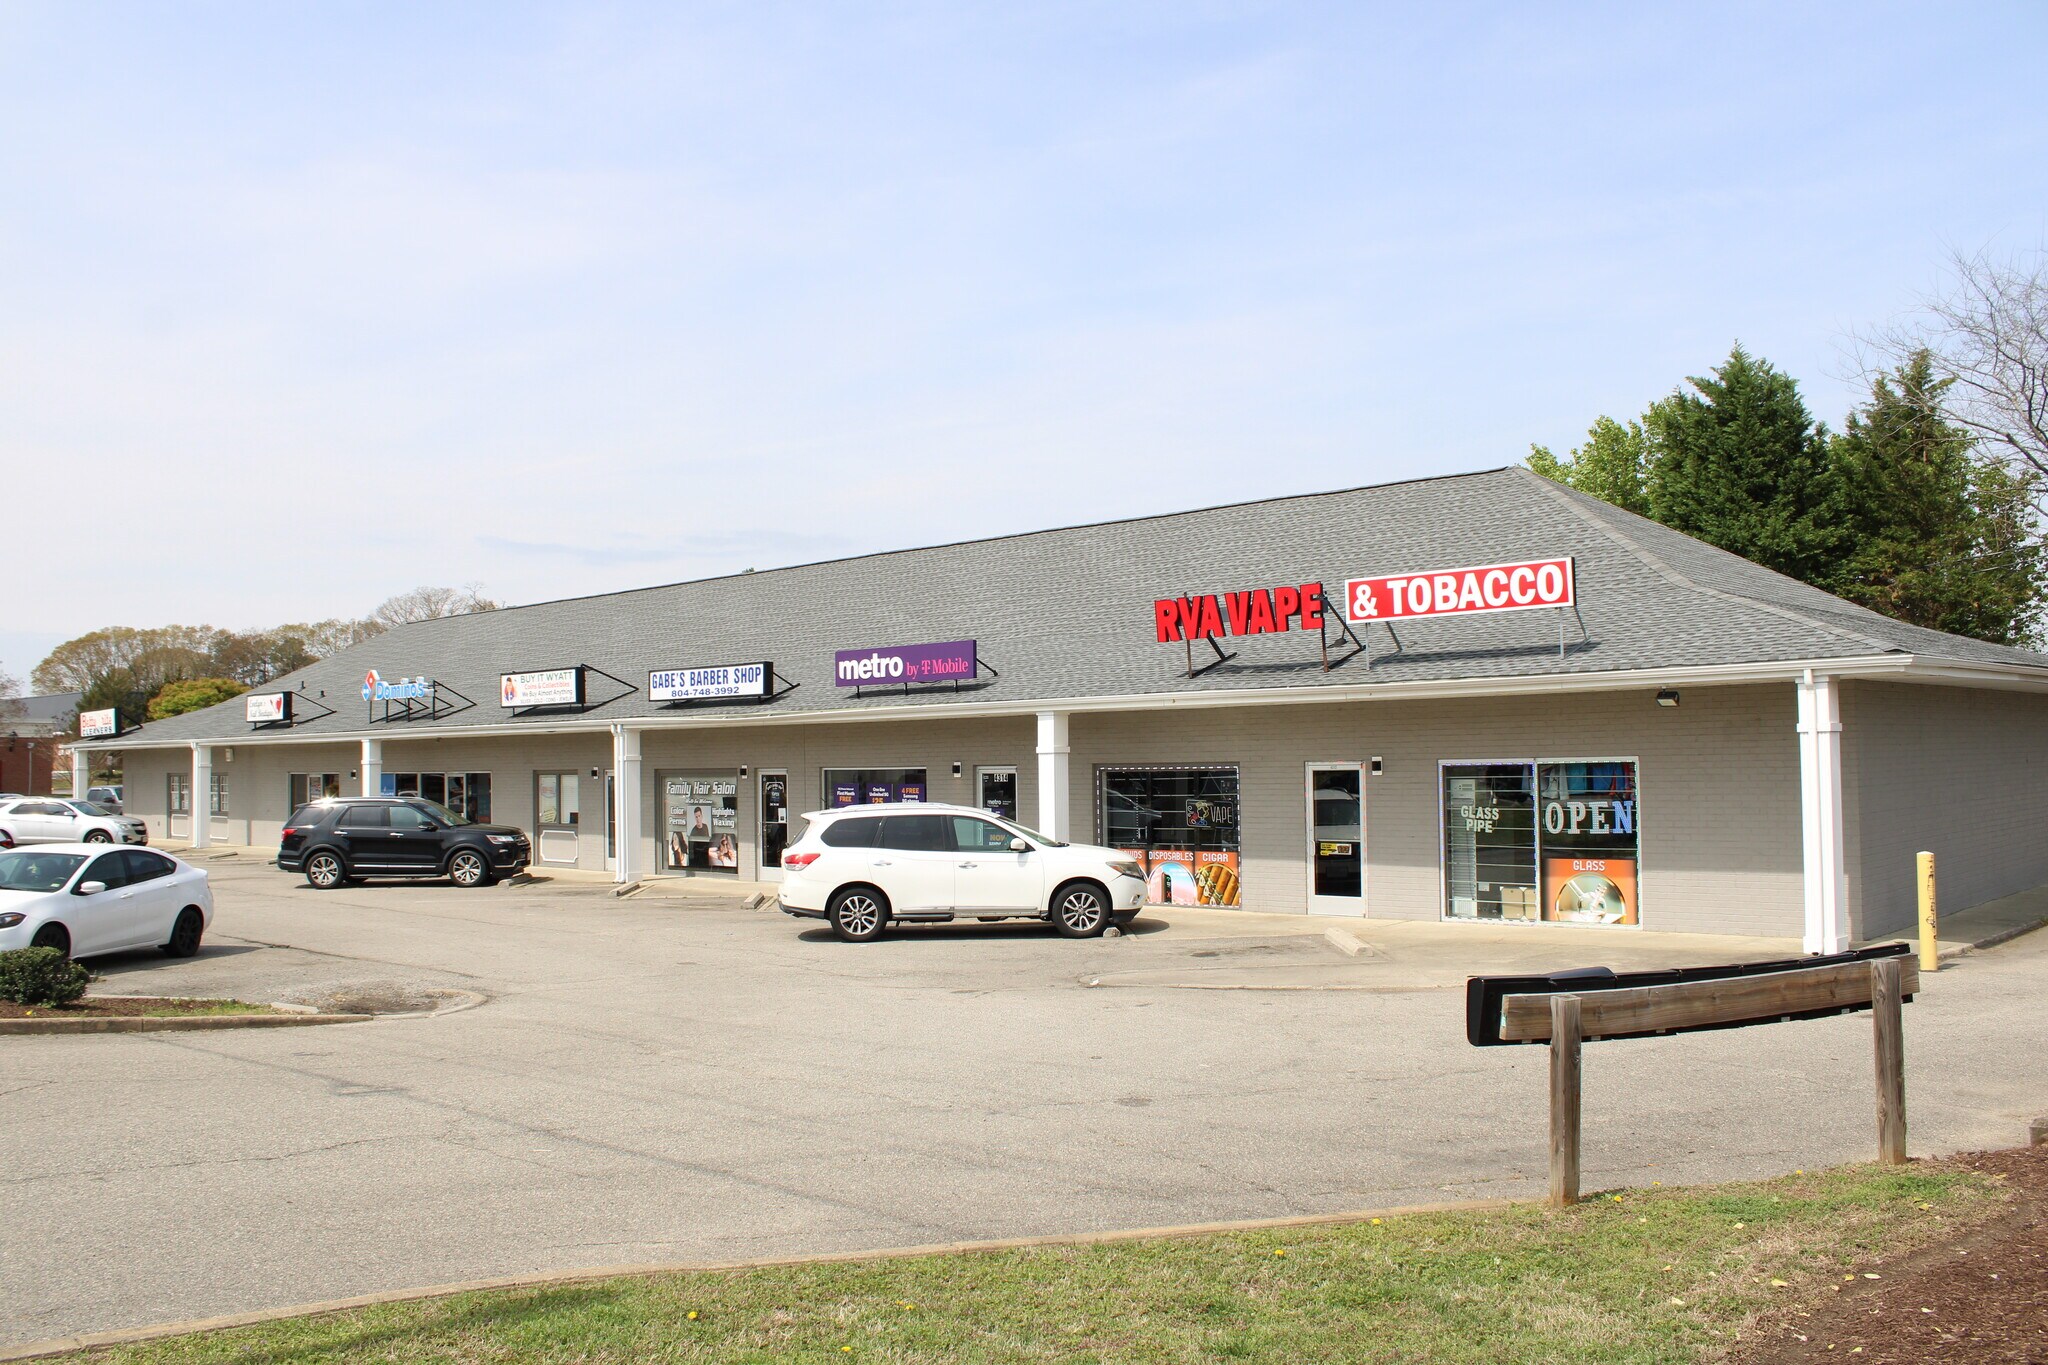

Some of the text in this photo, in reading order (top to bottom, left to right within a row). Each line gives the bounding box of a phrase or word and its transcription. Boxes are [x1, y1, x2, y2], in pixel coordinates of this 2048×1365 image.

[1353, 564, 1564, 618] & TOBACCO
[1154, 583, 1324, 642] RVA VAPE
[838, 652, 904, 680] metro
[906, 662, 919, 679] by
[520, 671, 573, 684] BUY IT WYATT
[652, 666, 762, 689] GABE'S BARBER SHOP
[538, 688, 553, 696] Almost
[554, 688, 573, 696] Anything
[671, 686, 740, 697] 804-748-3992
[82, 726, 113, 736] CLEANERS
[666, 781, 736, 797] Family Hair Salon
[670, 806, 685, 815] Color
[711, 807, 735, 817] Highlights
[1210, 806, 1233, 823] VAPE
[1461, 805, 1500, 820] GLASS
[668, 817, 686, 825] Perms
[713, 817, 735, 828] Waxing
[1545, 801, 1633, 834] OPEN
[1466, 819, 1493, 833] PIPE
[1148, 850, 1194, 861] DISPOSABLES
[1202, 853, 1229, 862] CIGAR
[1573, 860, 1605, 871] GLASS
